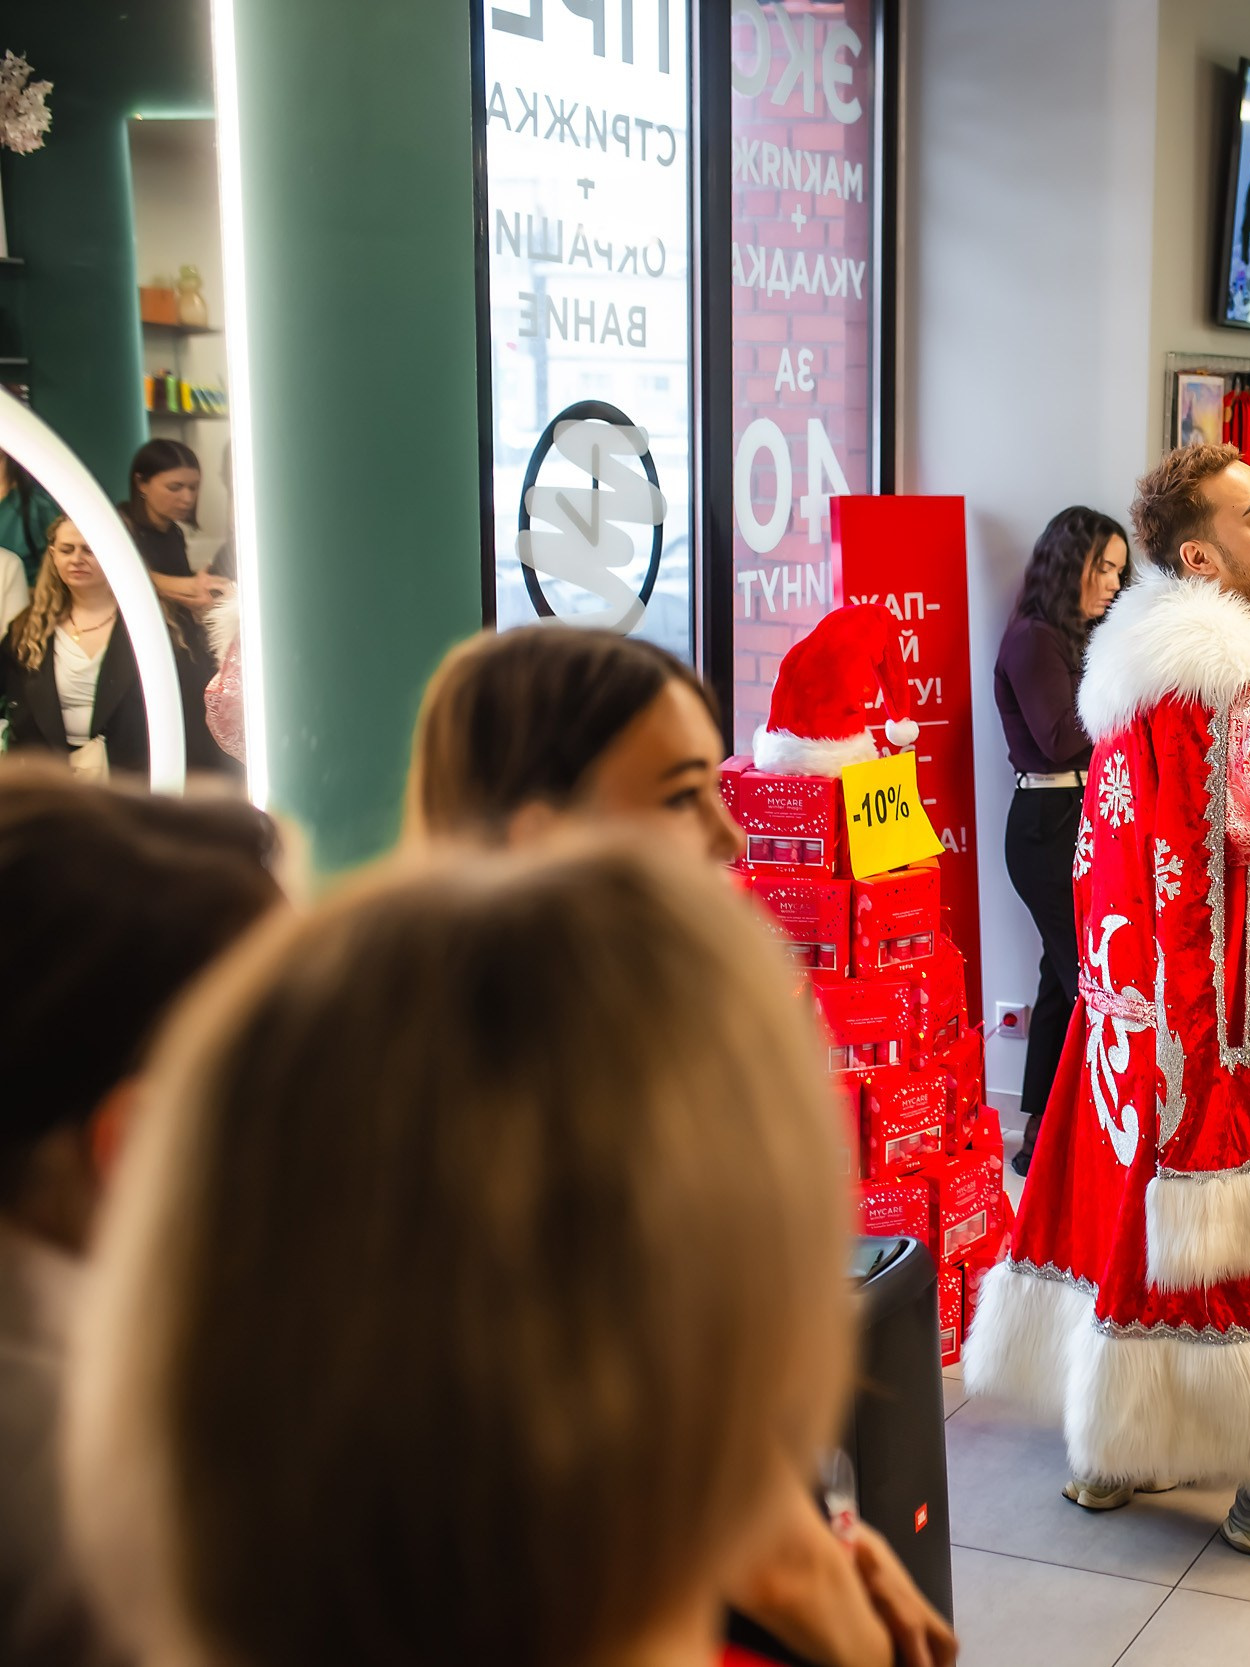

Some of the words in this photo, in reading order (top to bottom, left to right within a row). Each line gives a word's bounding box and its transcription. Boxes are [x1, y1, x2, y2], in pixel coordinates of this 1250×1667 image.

[767, 798, 803, 807] MYCARE
[853, 784, 910, 827] -10%
[869, 1205, 904, 1217] MYCARE
